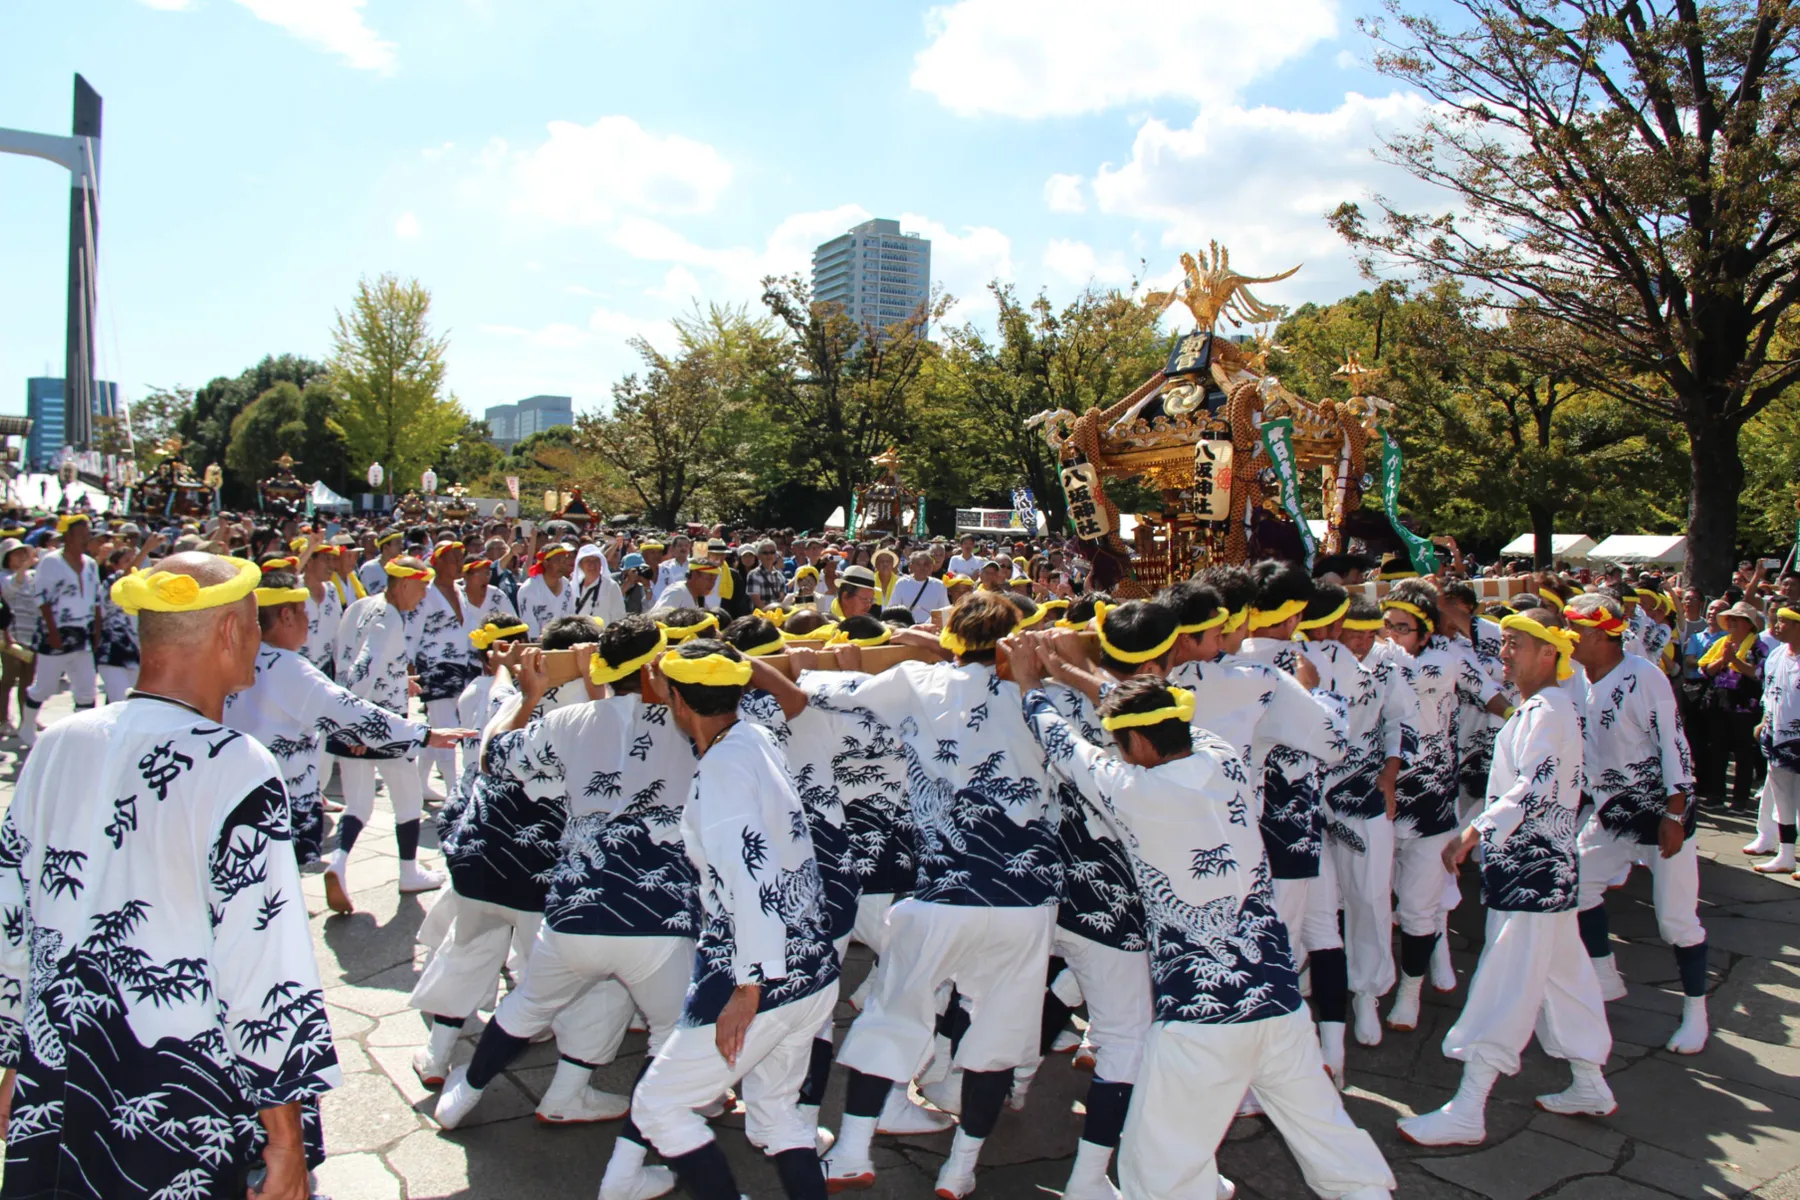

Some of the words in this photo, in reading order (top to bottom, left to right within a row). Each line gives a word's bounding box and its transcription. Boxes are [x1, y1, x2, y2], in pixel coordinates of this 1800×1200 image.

[1064, 469, 1102, 537] 八坂神社
[1194, 444, 1216, 516] 八坂神社
